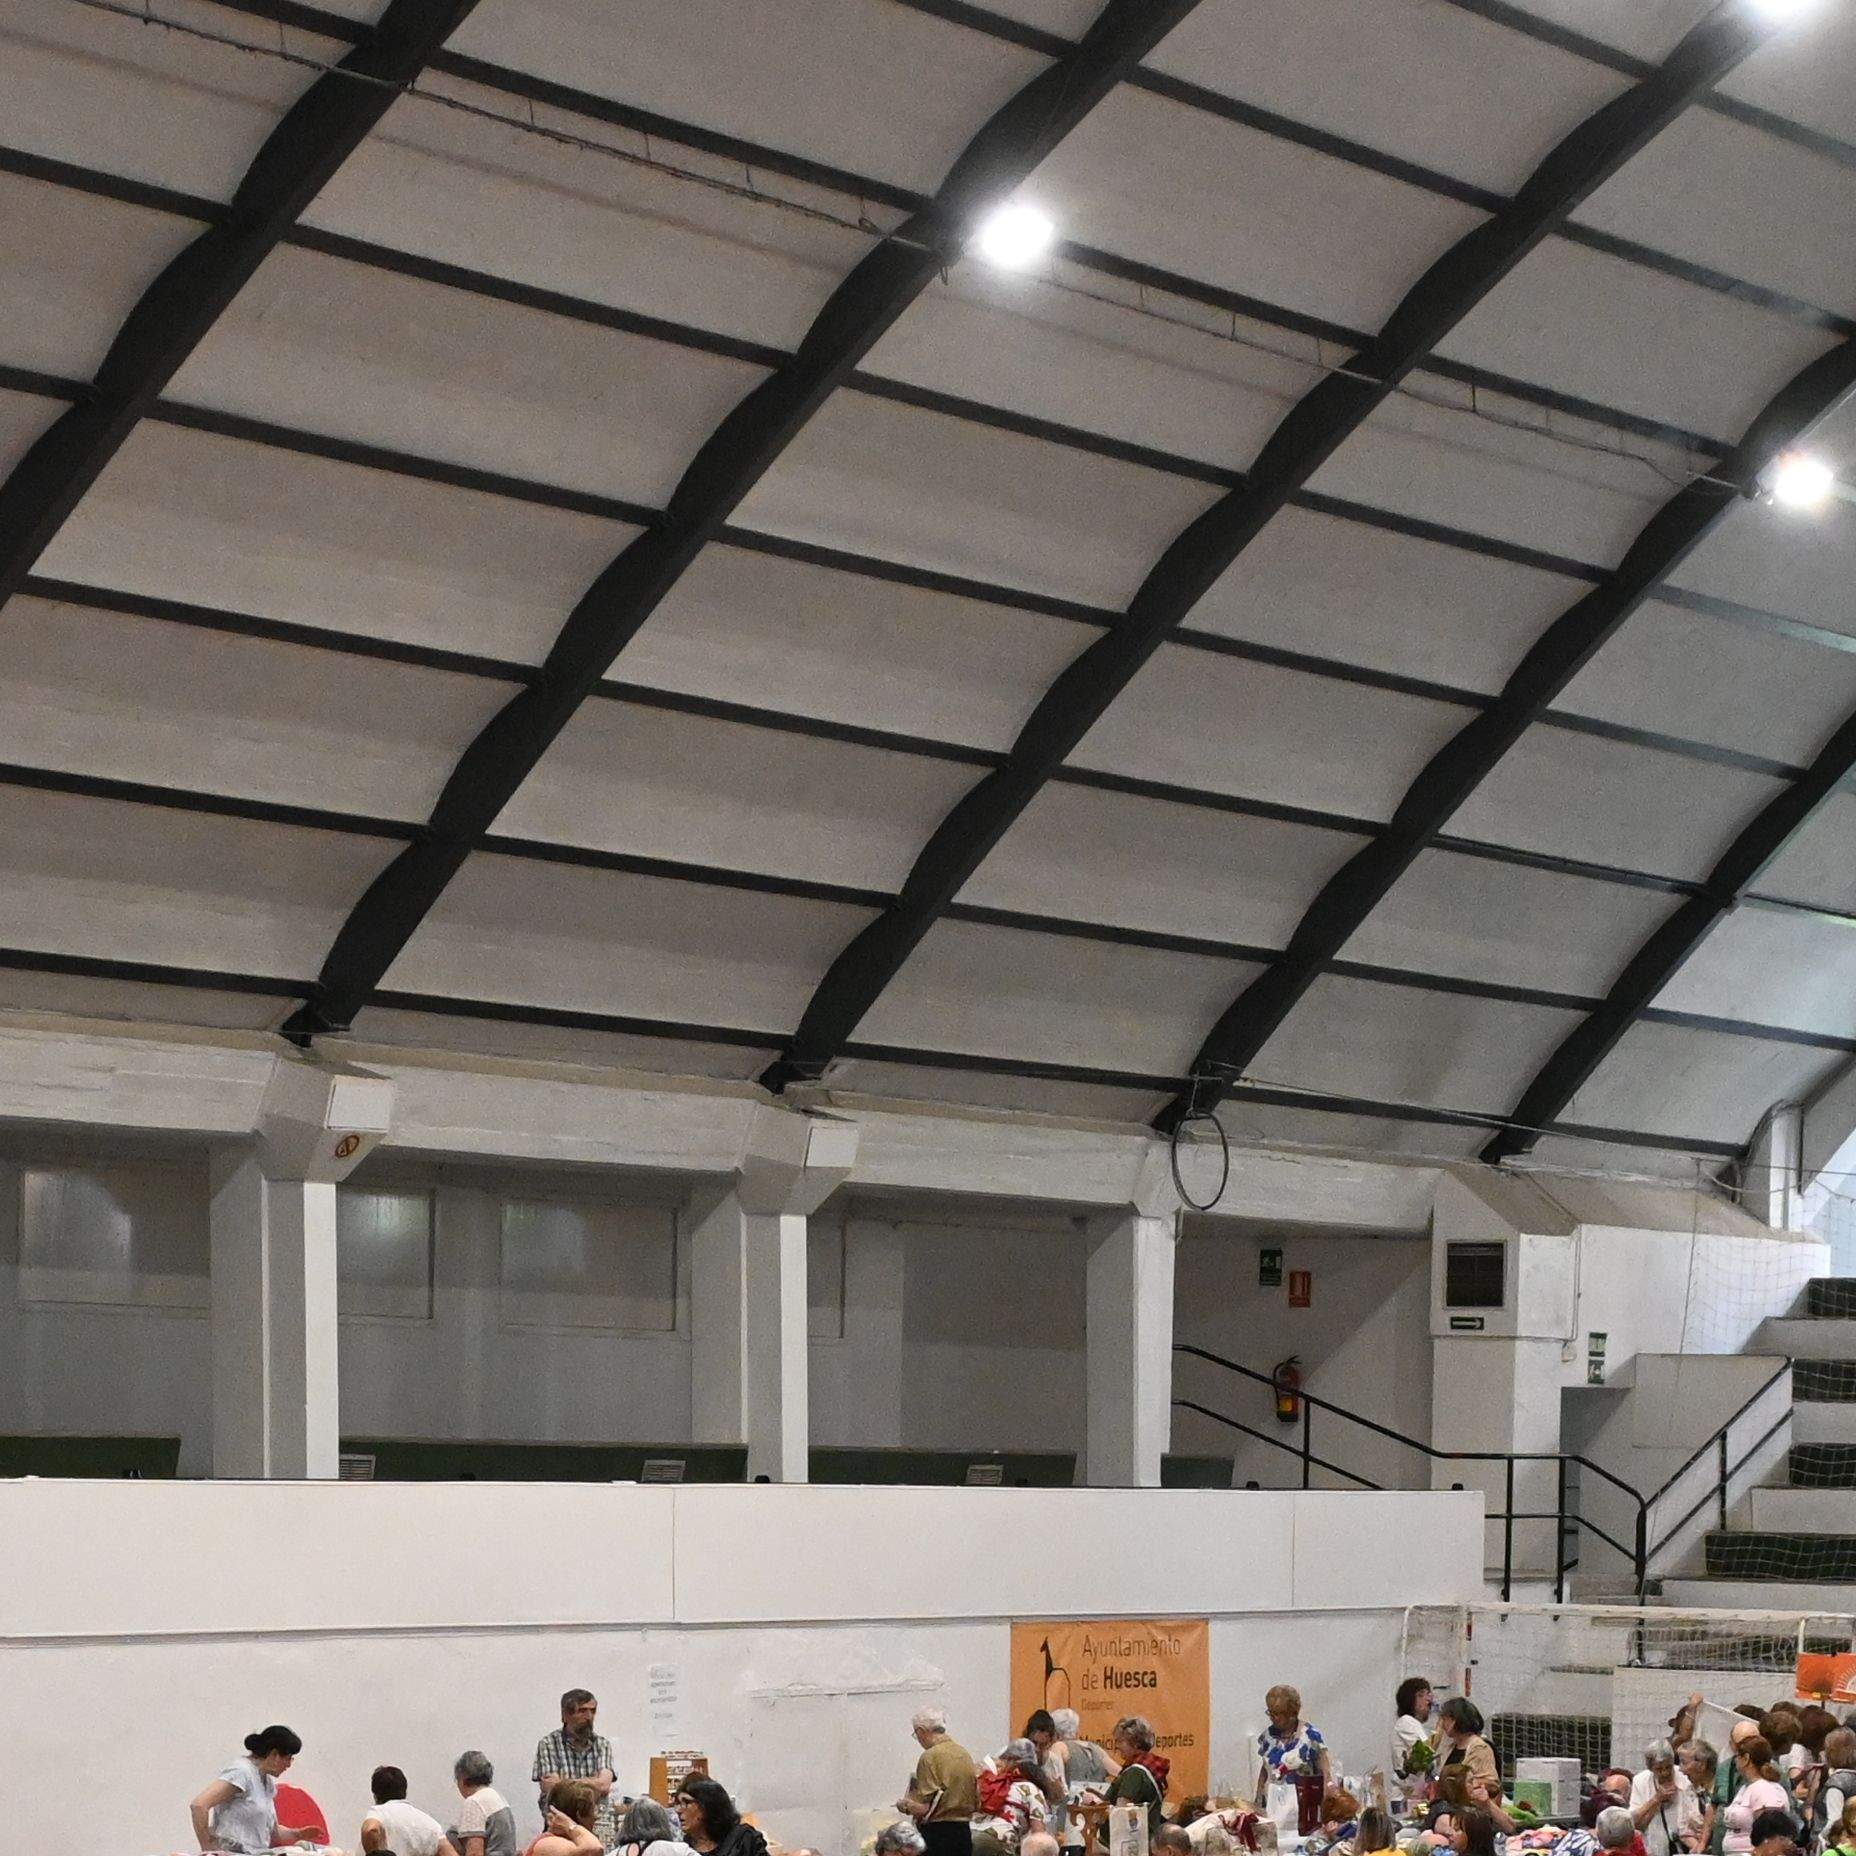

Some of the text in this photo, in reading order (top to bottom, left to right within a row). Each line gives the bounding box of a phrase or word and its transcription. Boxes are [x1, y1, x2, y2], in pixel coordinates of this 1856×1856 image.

[1082, 1634, 1182, 1664] Ayuntamiento
[1082, 1666, 1158, 1691] de Huesca
